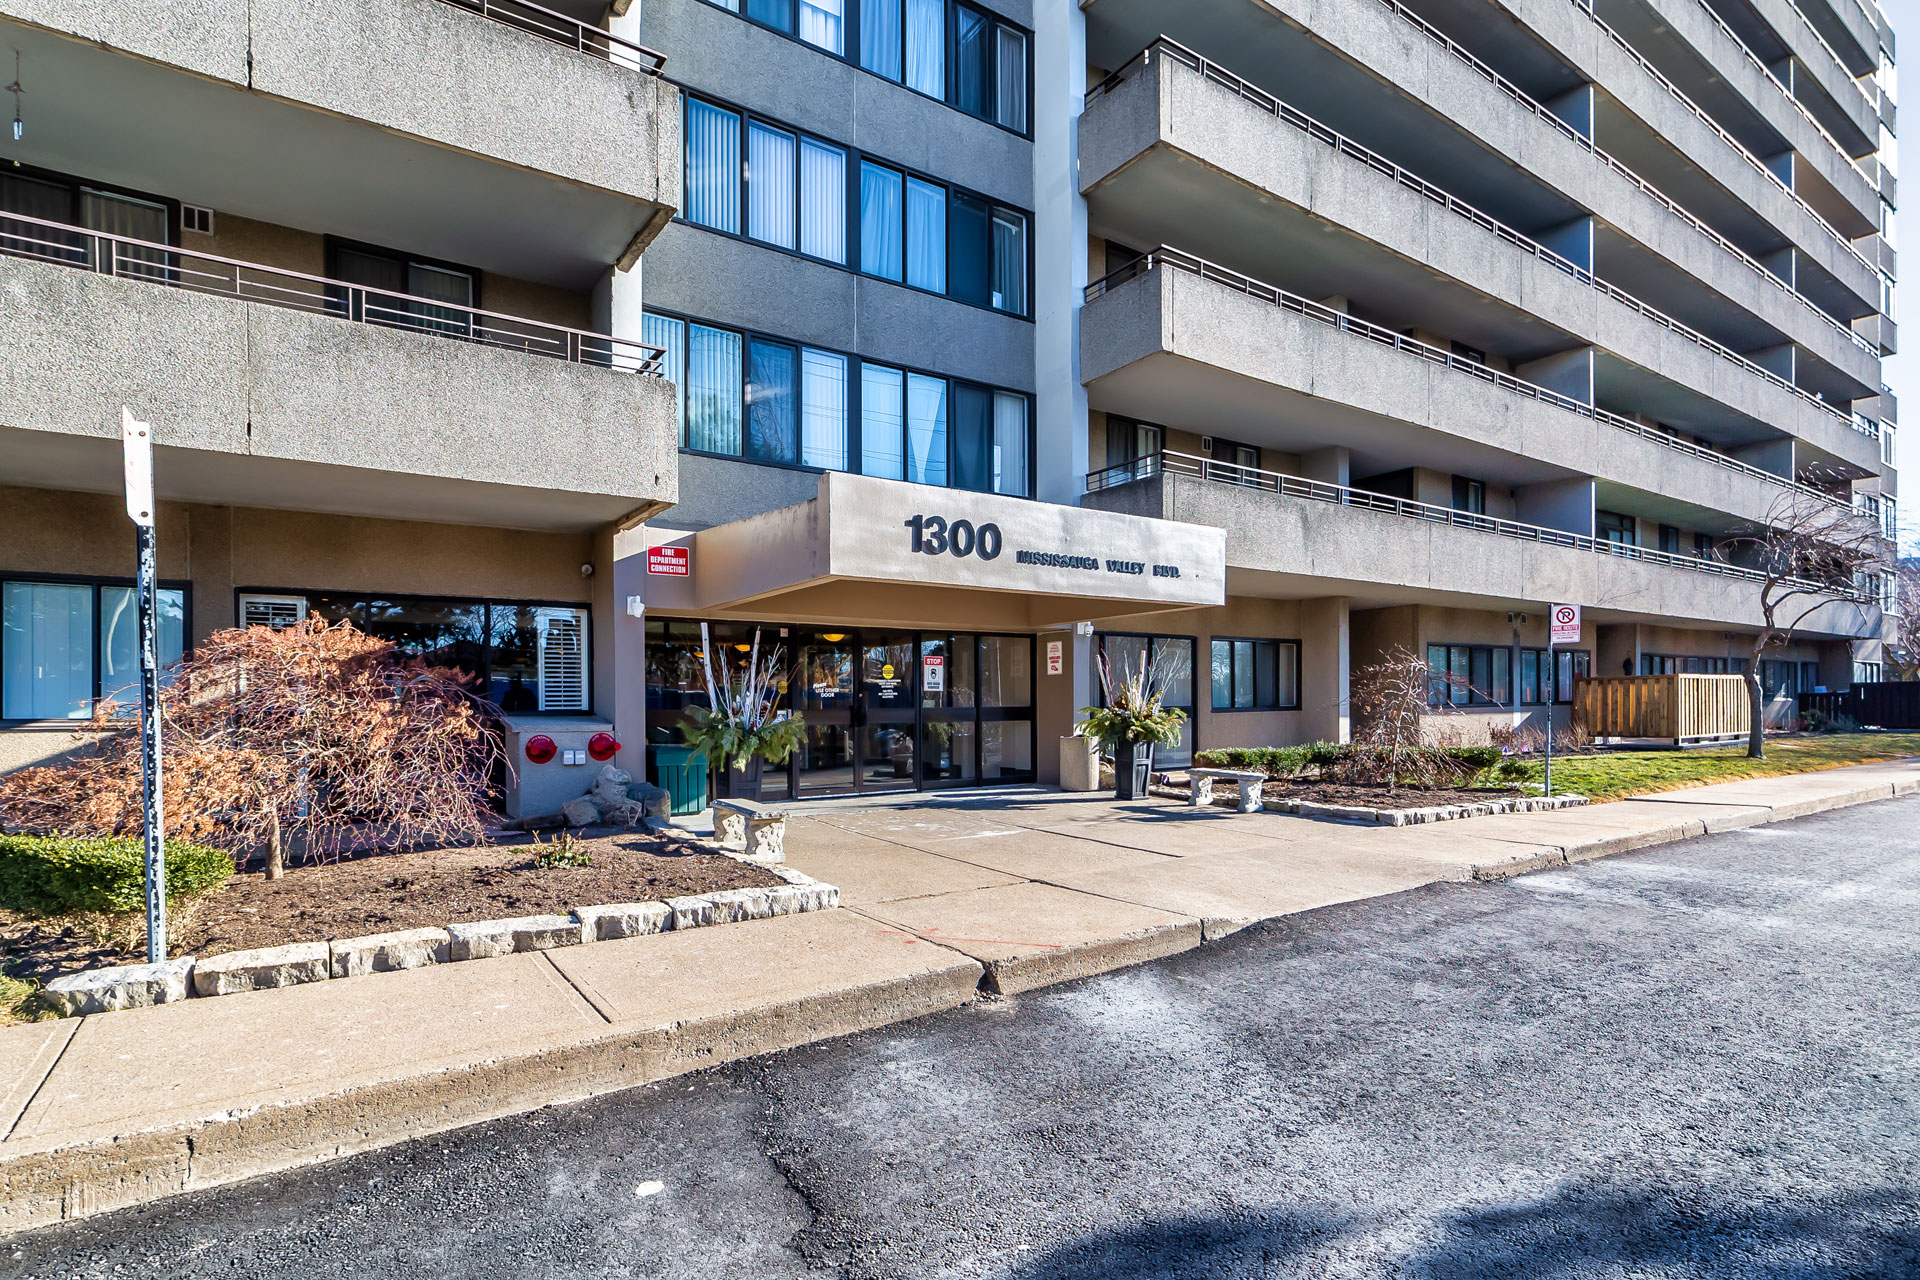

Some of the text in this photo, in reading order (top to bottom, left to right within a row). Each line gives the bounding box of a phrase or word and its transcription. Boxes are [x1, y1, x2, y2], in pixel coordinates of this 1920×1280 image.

[904, 514, 1002, 561] 1300
[661, 548, 675, 556] FIRE
[650, 556, 686, 565] DEPARTMENT
[1016, 550, 1099, 570] MISSISSAUGA
[1105, 559, 1146, 575] VALLEY
[651, 564, 686, 573] CONNECTION
